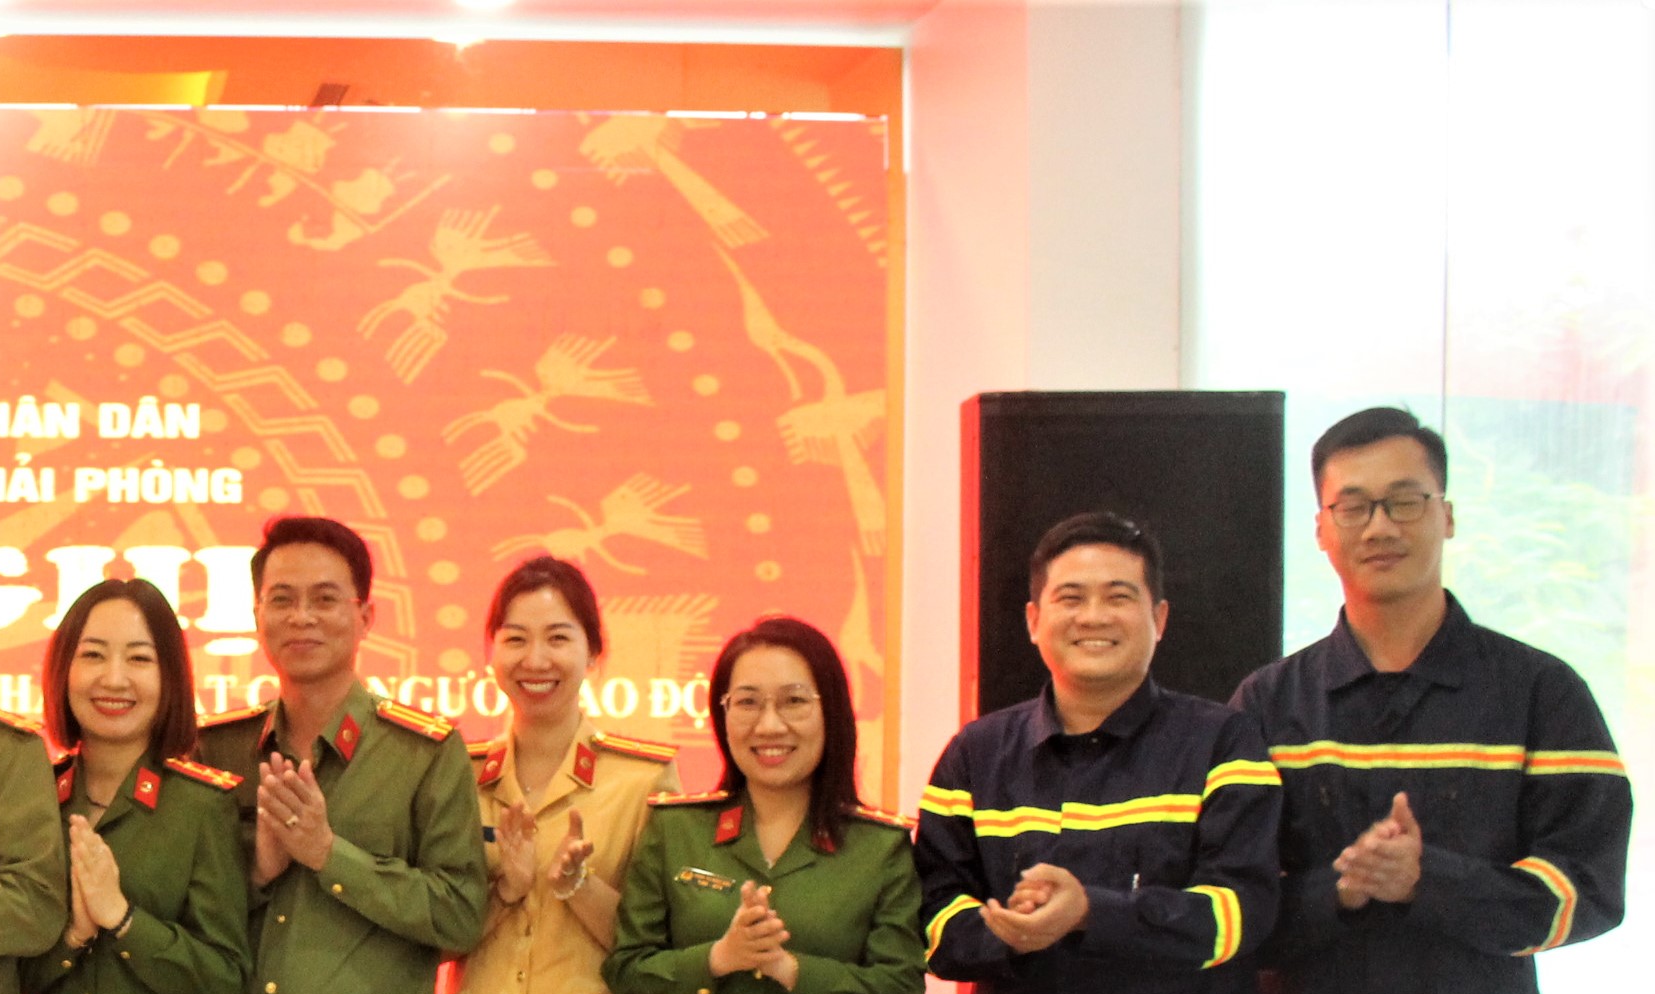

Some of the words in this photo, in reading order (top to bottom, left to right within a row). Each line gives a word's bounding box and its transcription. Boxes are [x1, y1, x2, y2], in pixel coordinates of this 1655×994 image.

[98, 396, 201, 439] DÂN
[74, 459, 242, 503] PHÒNG
[366, 665, 509, 717] NGƯỜ
[578, 677, 639, 718] AO
